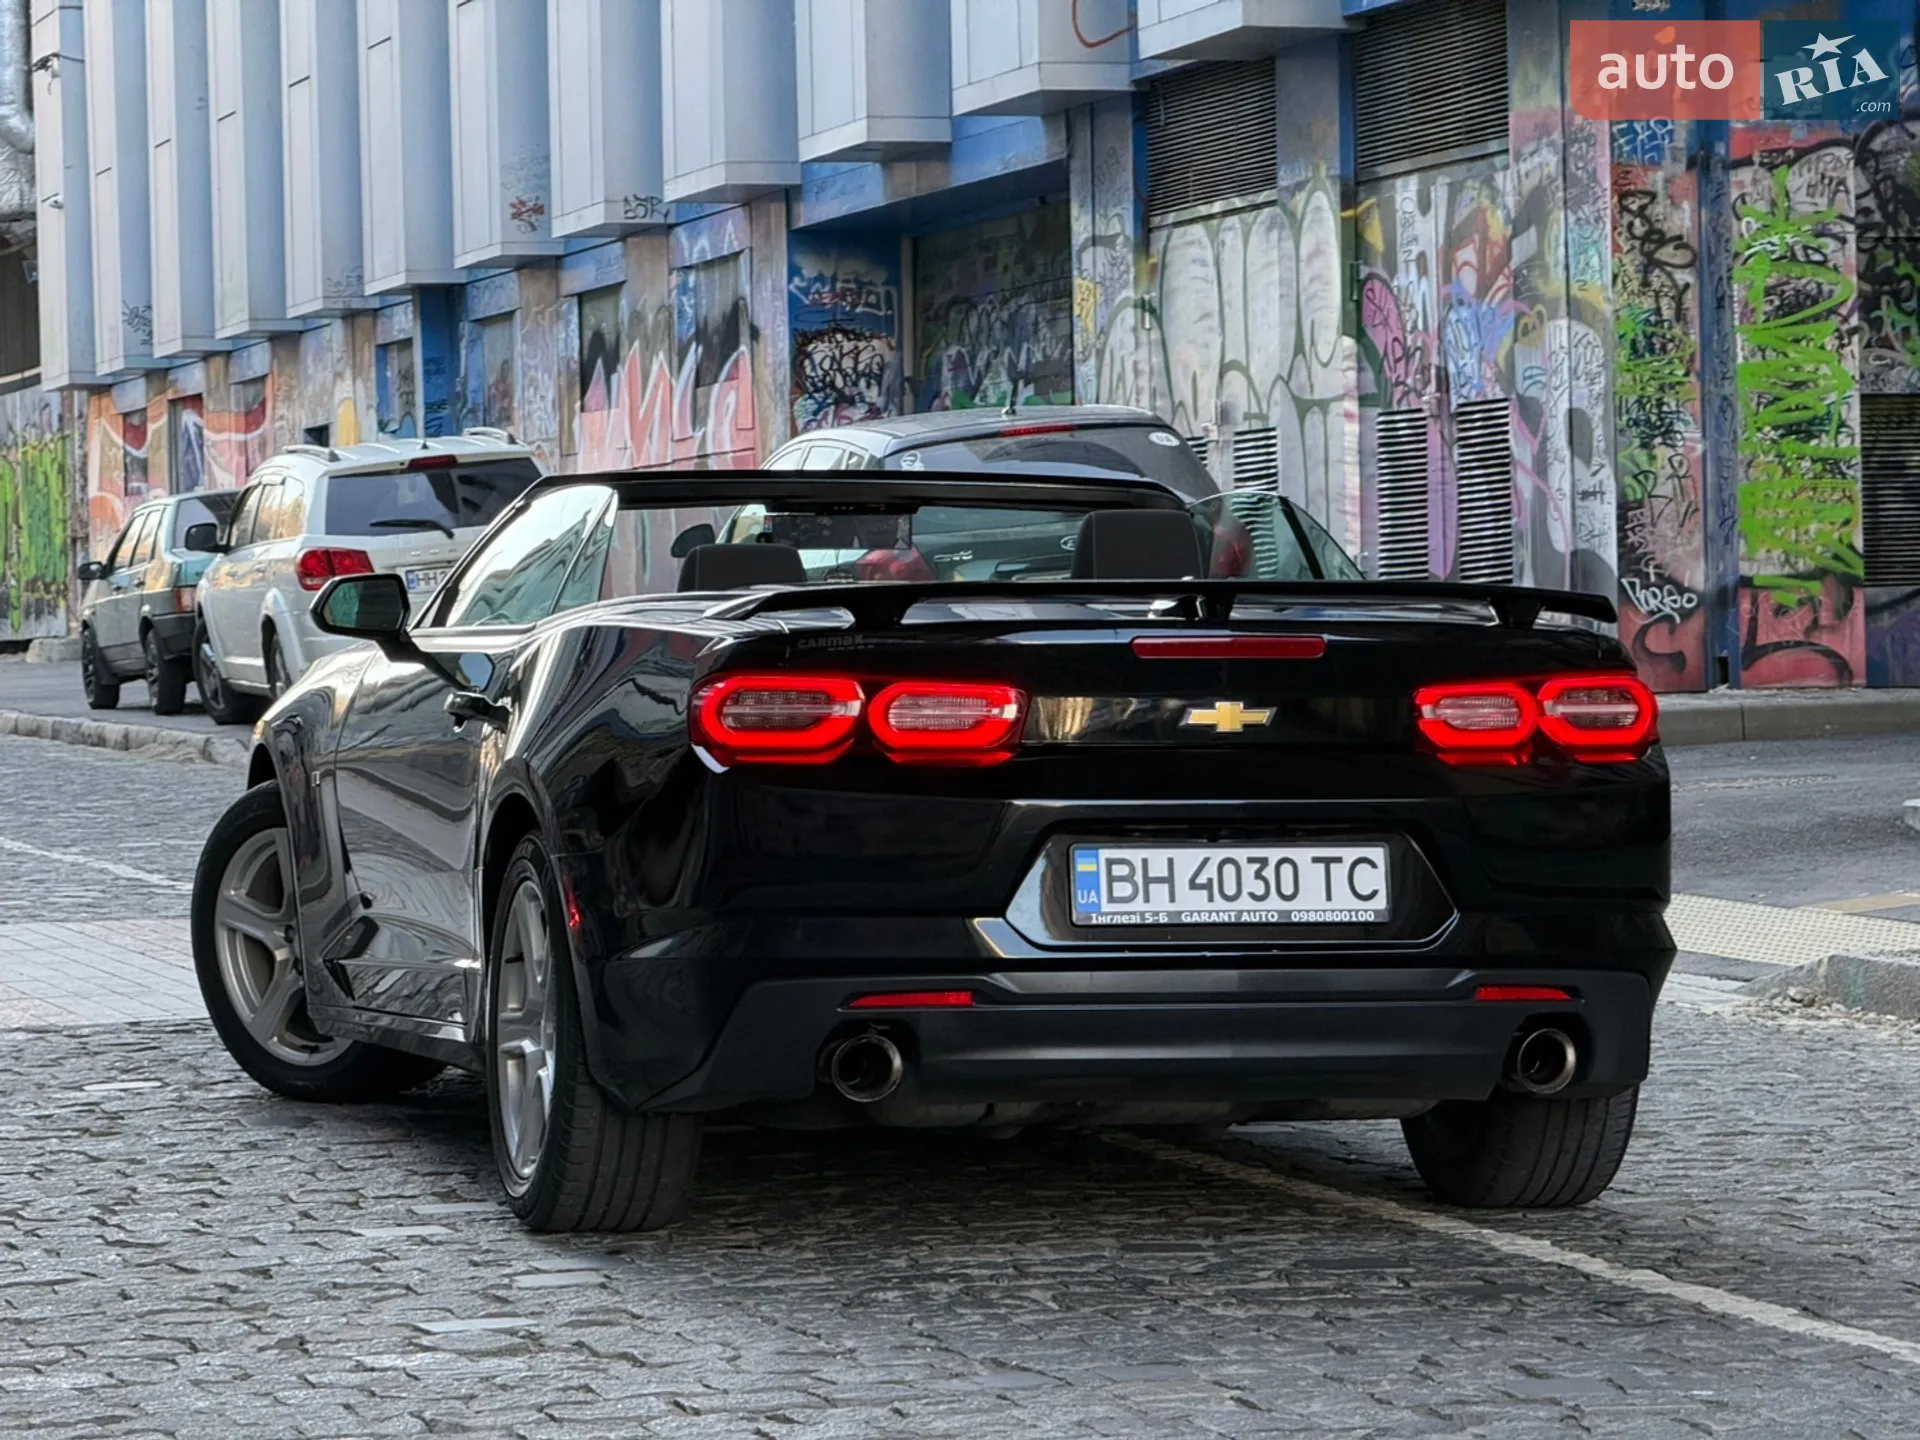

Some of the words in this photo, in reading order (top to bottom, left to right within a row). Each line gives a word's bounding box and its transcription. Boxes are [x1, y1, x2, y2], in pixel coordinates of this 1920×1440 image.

[1104, 856, 1176, 904] BH
[1187, 856, 1300, 903] 4030
[1311, 856, 1379, 902] TC
[1077, 889, 1099, 905] UA
[1090, 913, 1141, 924] Інглезі
[1145, 912, 1169, 923] 5-Б
[1181, 911, 1237, 923] GARANT
[1240, 910, 1279, 922] AUTO
[1290, 910, 1375, 922] 0980800100
